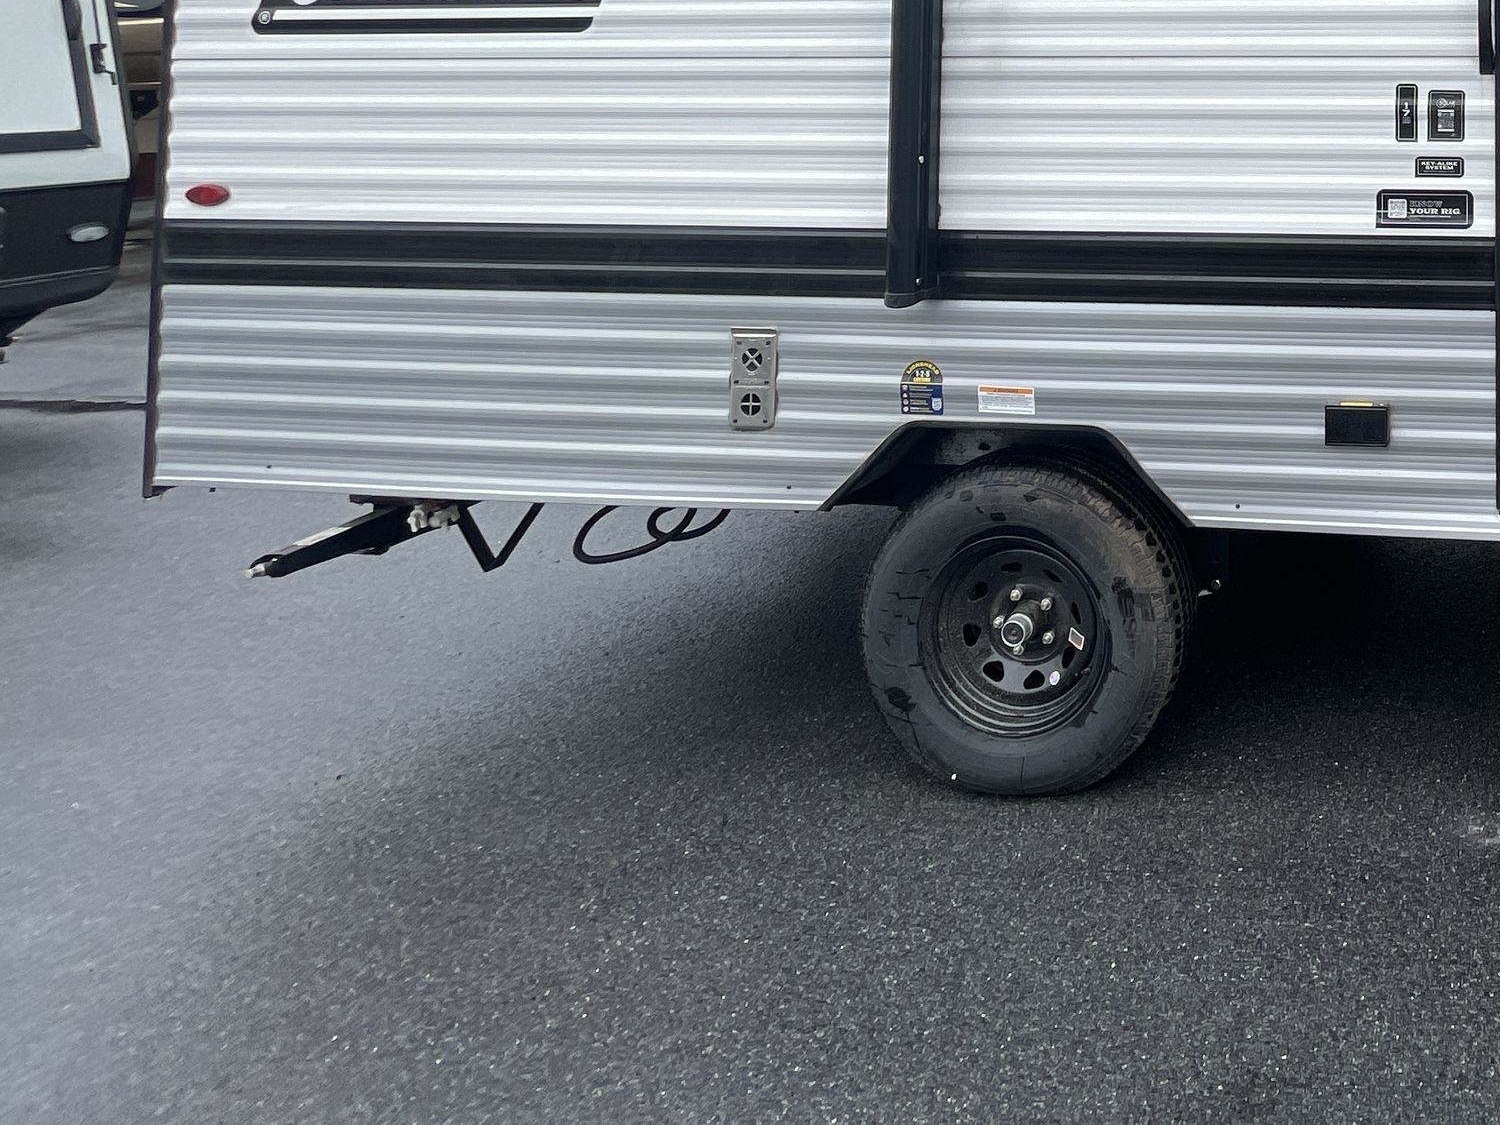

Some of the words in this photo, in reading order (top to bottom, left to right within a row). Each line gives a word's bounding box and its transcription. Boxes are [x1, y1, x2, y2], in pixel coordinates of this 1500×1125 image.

[1409, 200, 1443, 208] KNOW
[1409, 207, 1439, 215] YOUR
[1440, 207, 1461, 215] RIG
